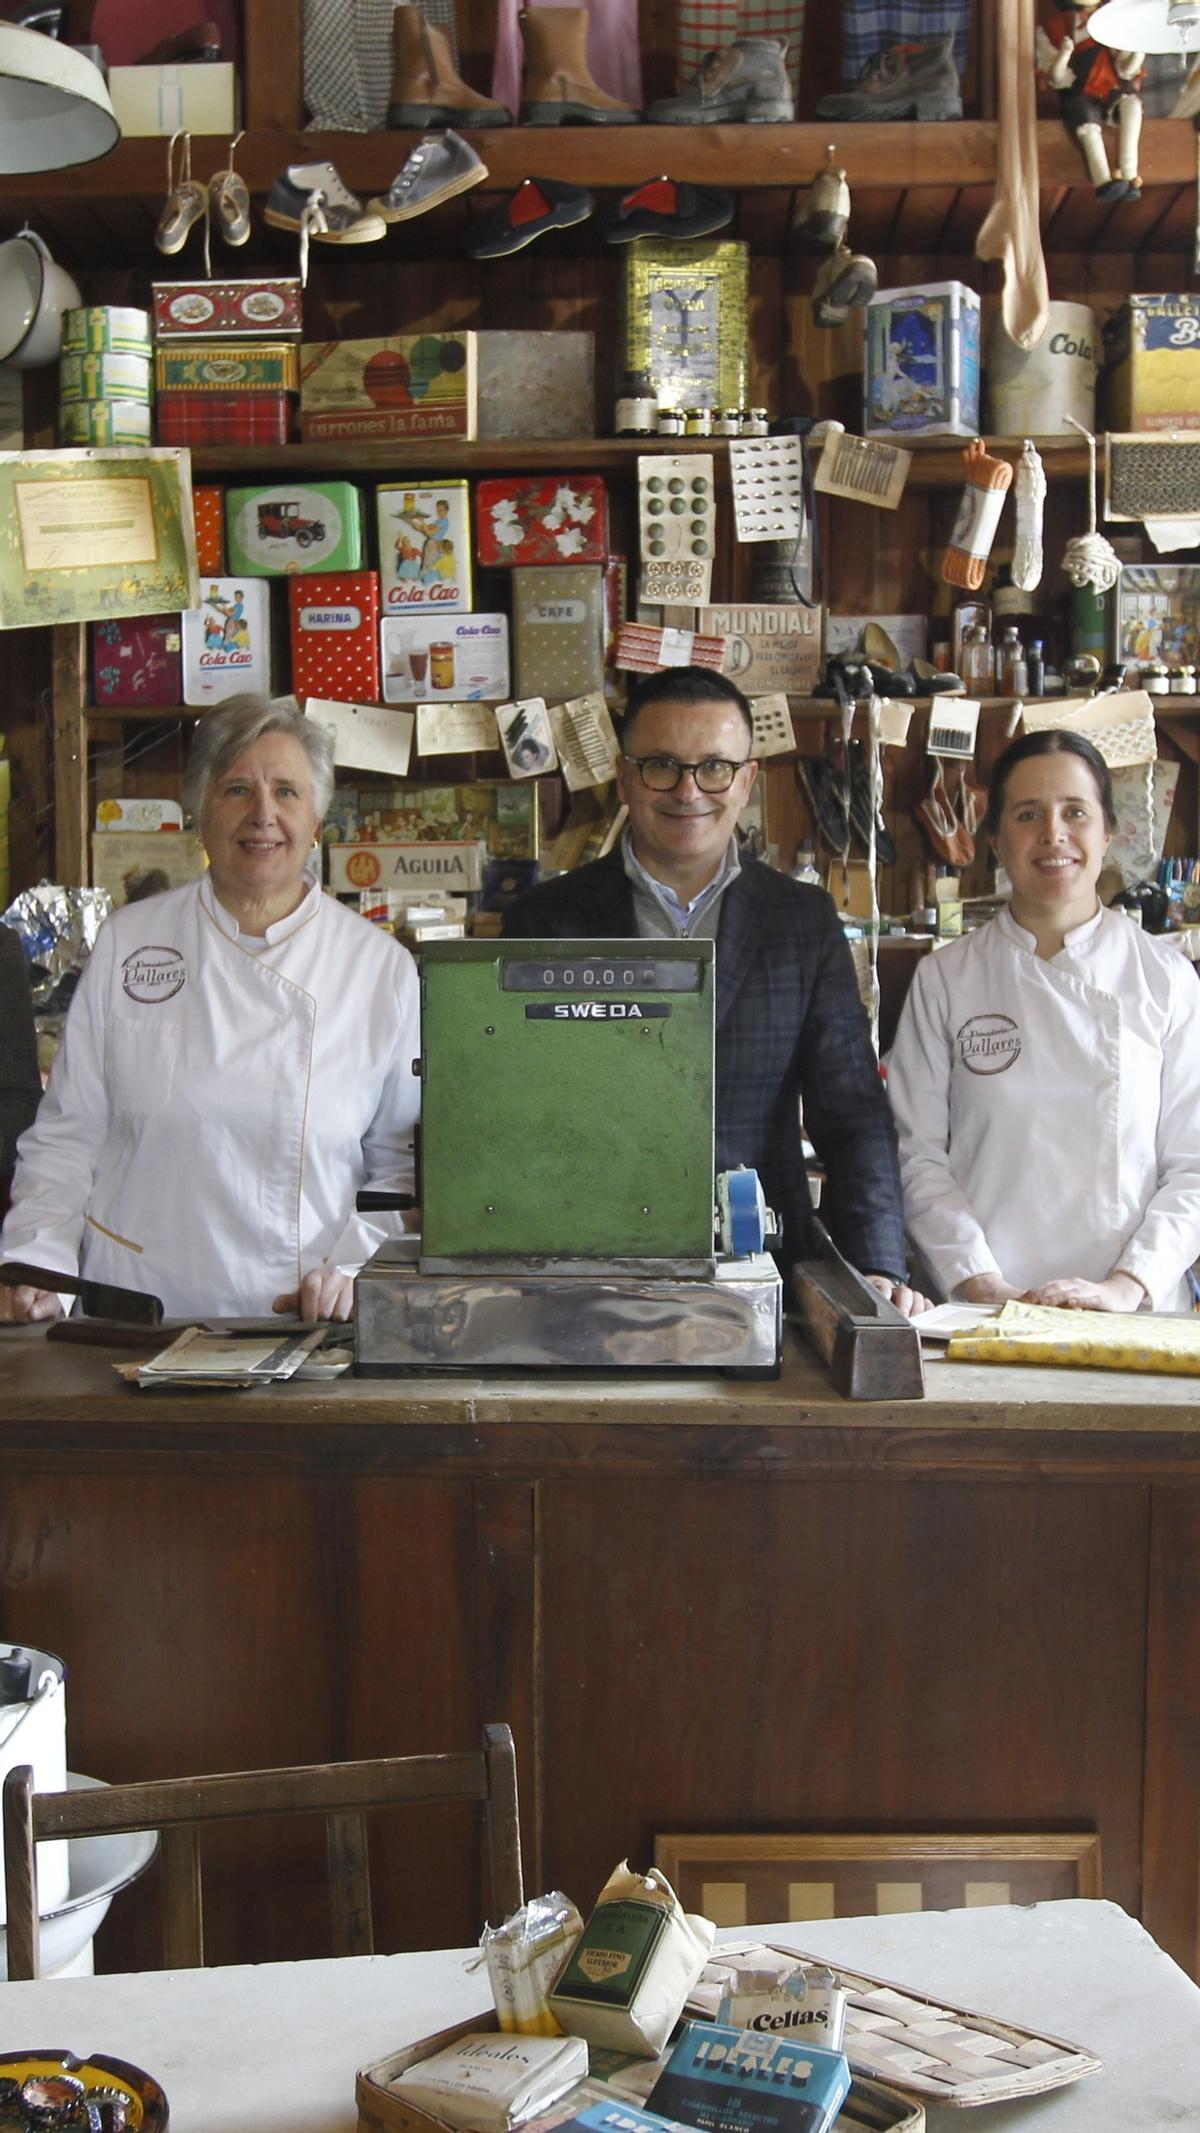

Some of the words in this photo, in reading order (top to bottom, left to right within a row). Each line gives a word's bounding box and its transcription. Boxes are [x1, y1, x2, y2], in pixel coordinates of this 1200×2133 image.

[1049, 333, 1092, 360] Cola
[391, 414, 407, 433] la
[388, 586, 424, 604] Cola
[429, 584, 460, 601] Cao
[308, 613, 352, 624] HARINA
[711, 610, 814, 636] MUNDIAL
[456, 626, 479, 636] Cola
[199, 653, 226, 666] Cola
[229, 651, 253, 664] Cao
[122, 968, 186, 984] Pallares
[554, 1003, 643, 1018] SWEDA
[959, 1037, 1022, 1057] Pallares
[753, 2009, 829, 2032] Celtas
[456, 2043, 529, 2063] Ideales
[696, 2041, 814, 2083] IDEALES
[719, 2122, 750, 2133] BLANCO
